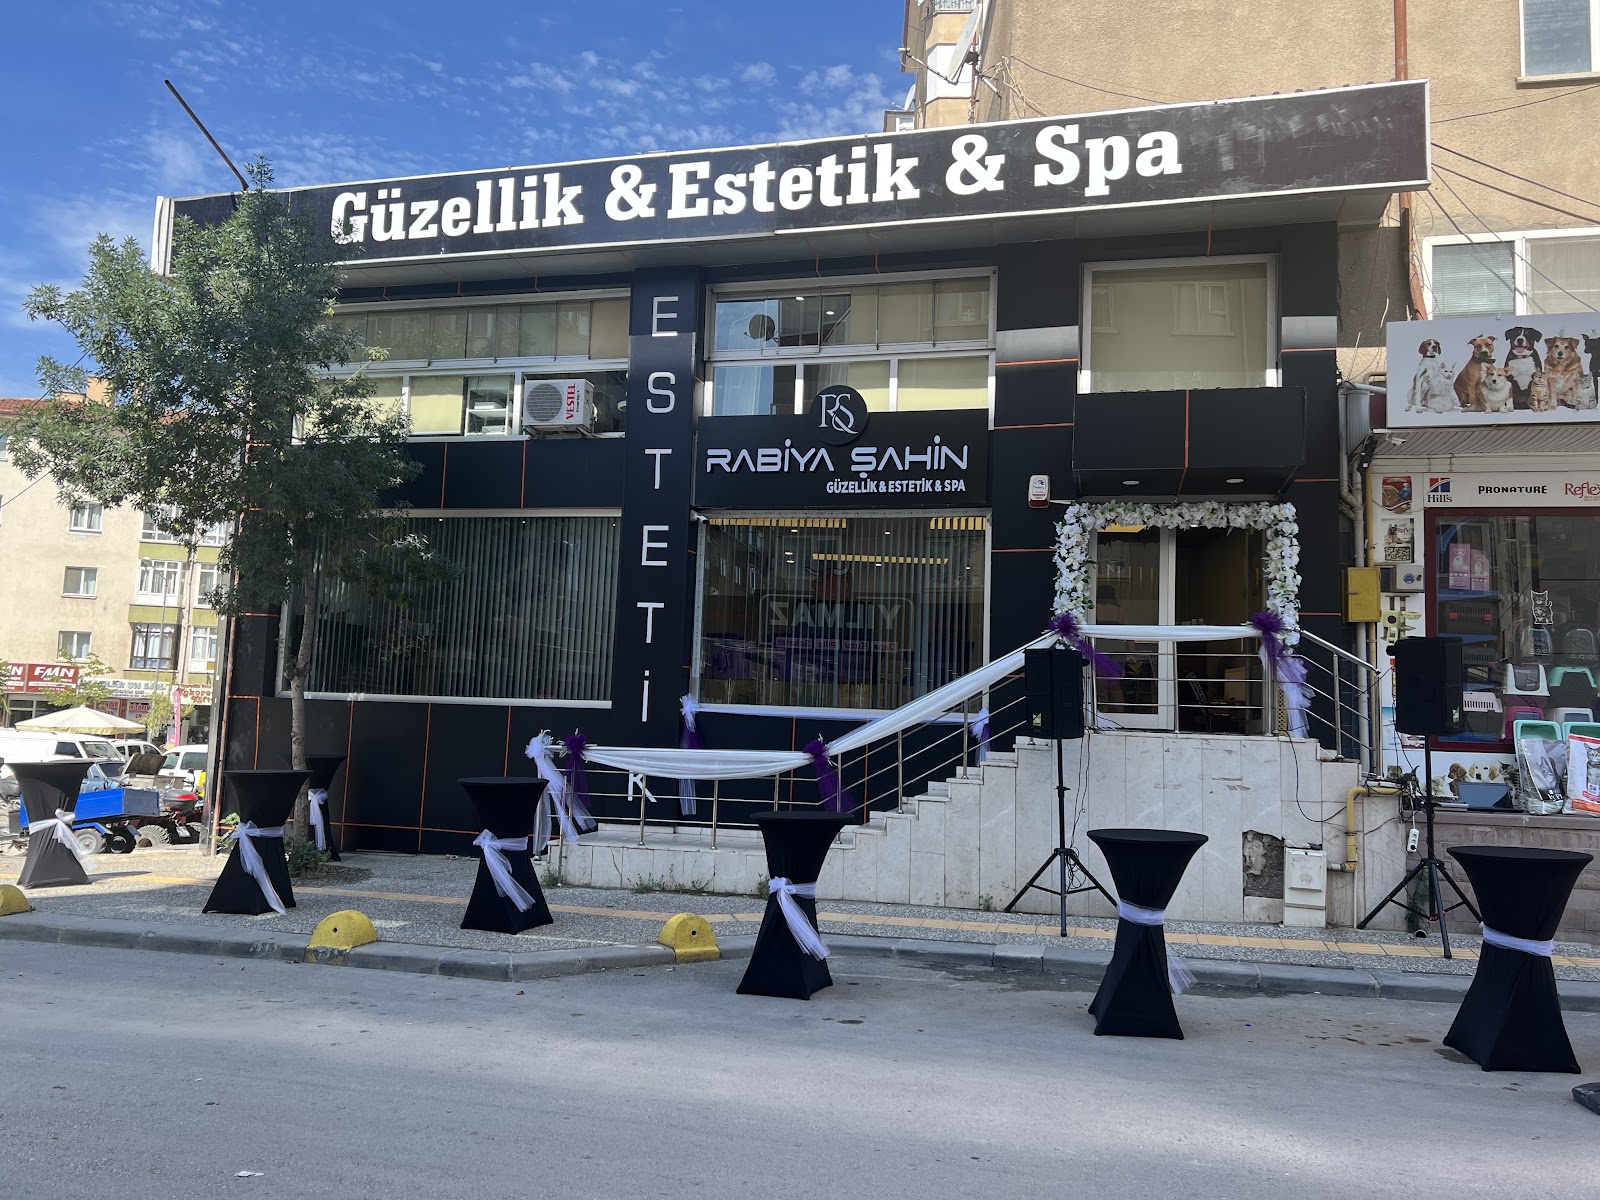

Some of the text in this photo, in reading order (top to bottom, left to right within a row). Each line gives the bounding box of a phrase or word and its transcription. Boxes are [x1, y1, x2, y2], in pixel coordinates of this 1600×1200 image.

[331, 123, 1183, 246] Güzellik & Estetik & Spa
[565, 383, 576, 420] VESTEL
[706, 434, 968, 478] RABİYA ŞAHİN
[826, 477, 966, 494] GÜZELLİK & ESTETİK & SPA
[1478, 485, 1548, 495] PRONATURE
[1427, 494, 1453, 503] Hill's
[34, 666, 76, 678] FMN
[179, 688, 212, 698] Kokore
